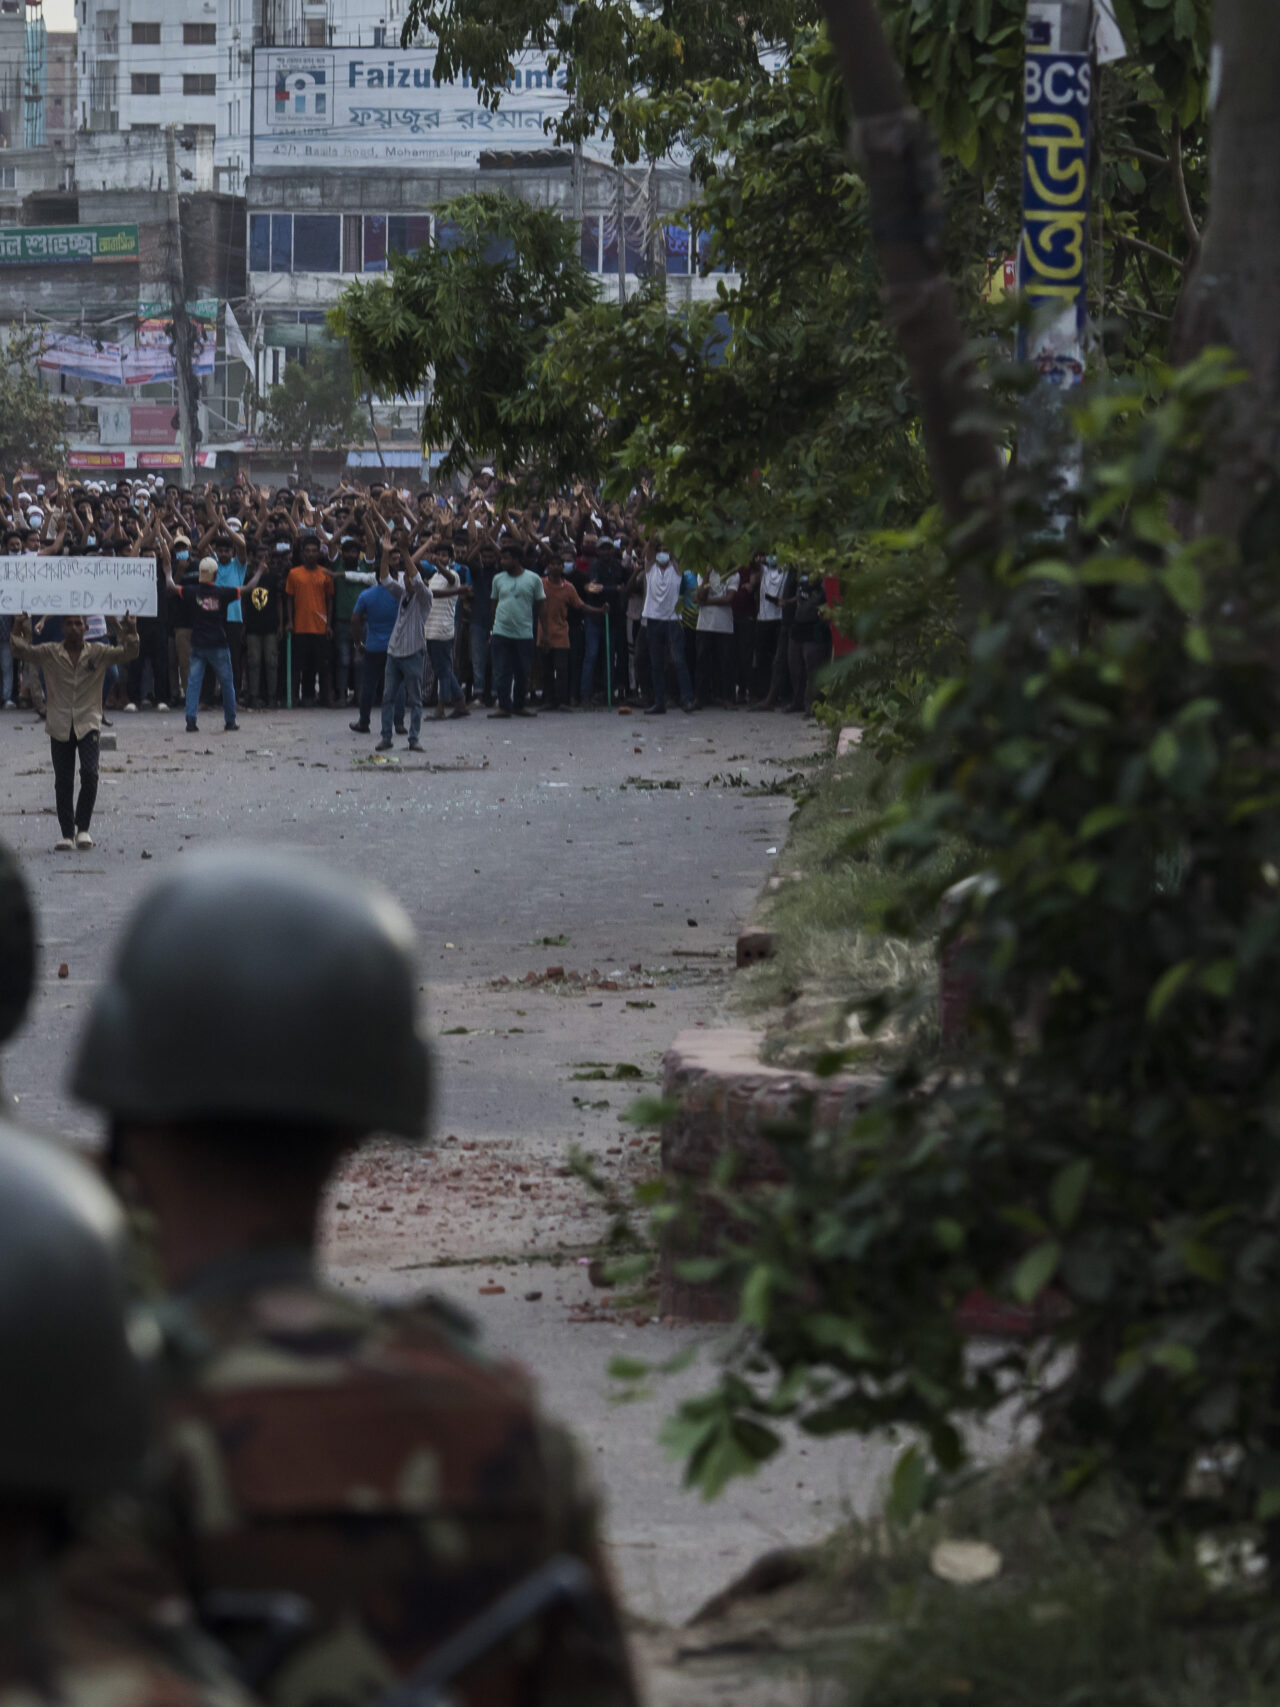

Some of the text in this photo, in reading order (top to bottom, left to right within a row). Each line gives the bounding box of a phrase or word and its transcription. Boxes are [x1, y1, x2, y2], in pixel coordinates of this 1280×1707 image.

[349, 60, 440, 88] Faizu
[1025, 60, 1090, 106] BCS
[349, 106, 545, 134] ফয়জুর রহমান
[25, 232, 98, 256] শুভেচ্ছা
[20, 589, 63, 611] Love
[70, 590, 95, 609] BD
[100, 592, 149, 613] Army
